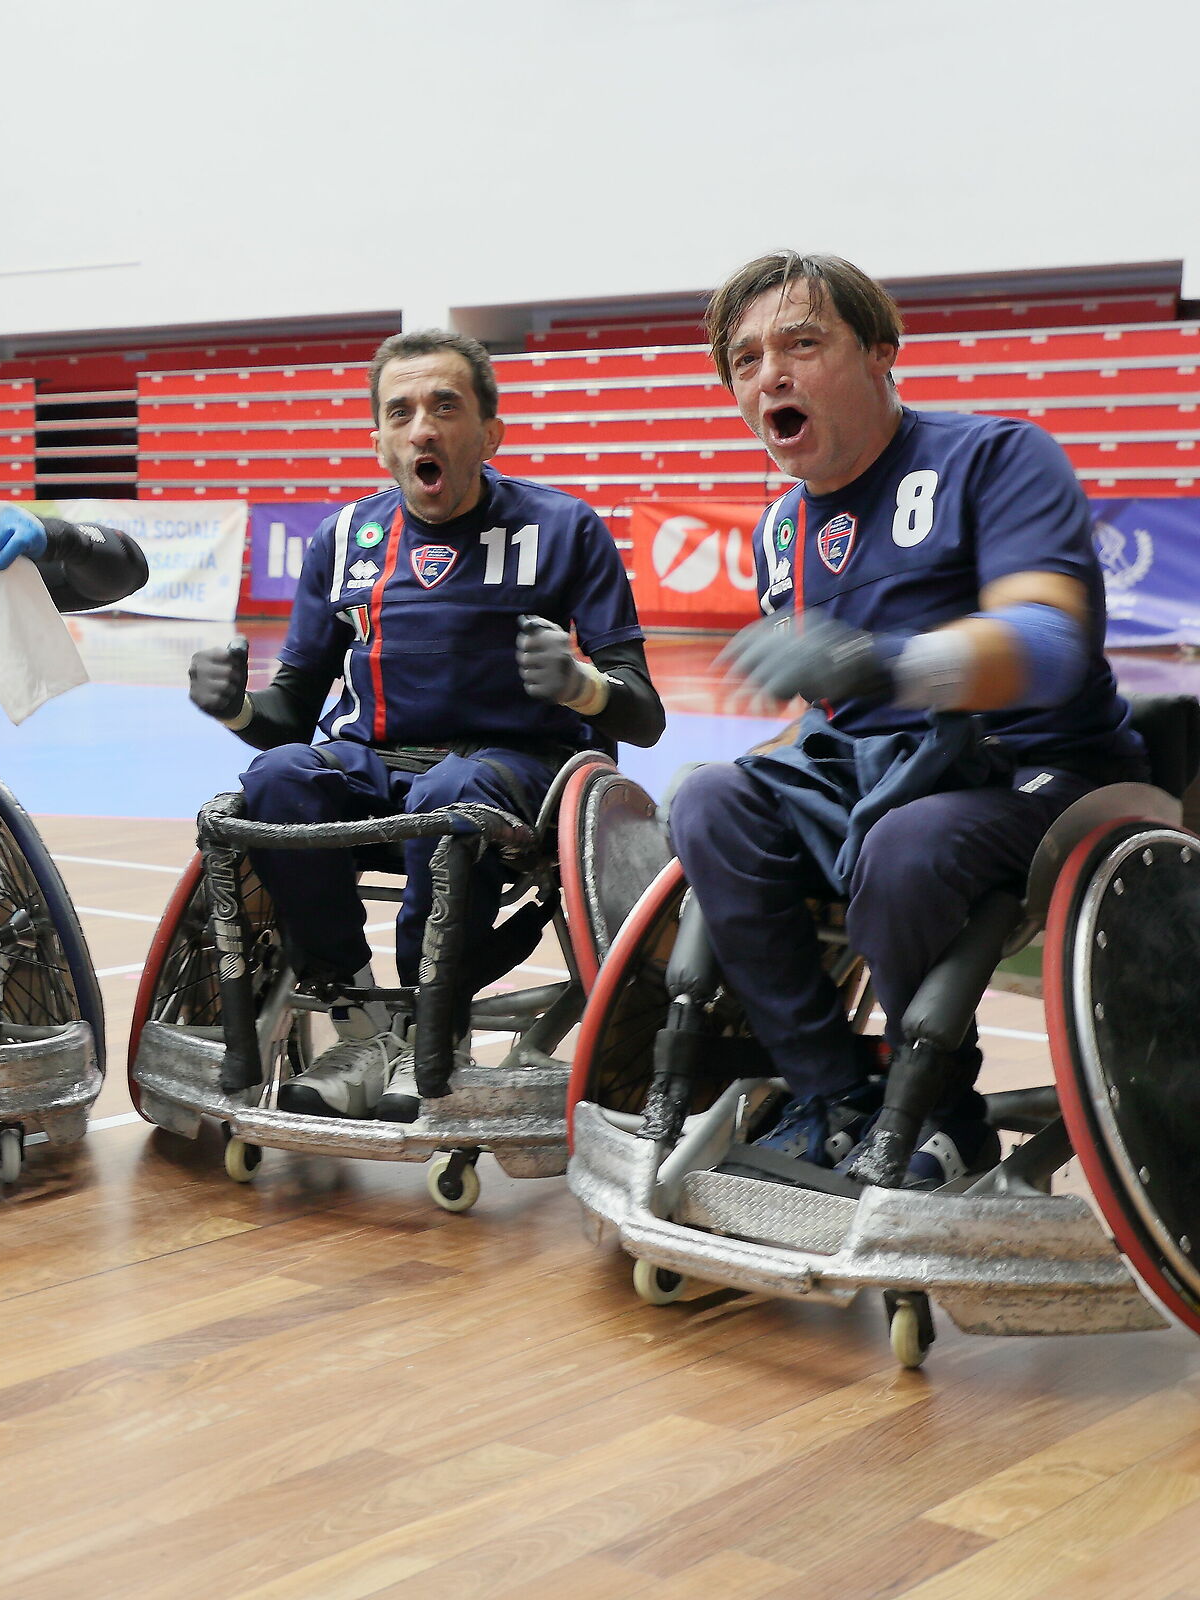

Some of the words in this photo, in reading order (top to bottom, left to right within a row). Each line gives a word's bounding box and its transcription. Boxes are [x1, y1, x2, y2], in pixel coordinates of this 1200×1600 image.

[154, 518, 222, 539] SOCIALE
[891, 469, 939, 548] 8
[480, 524, 540, 586] 11
